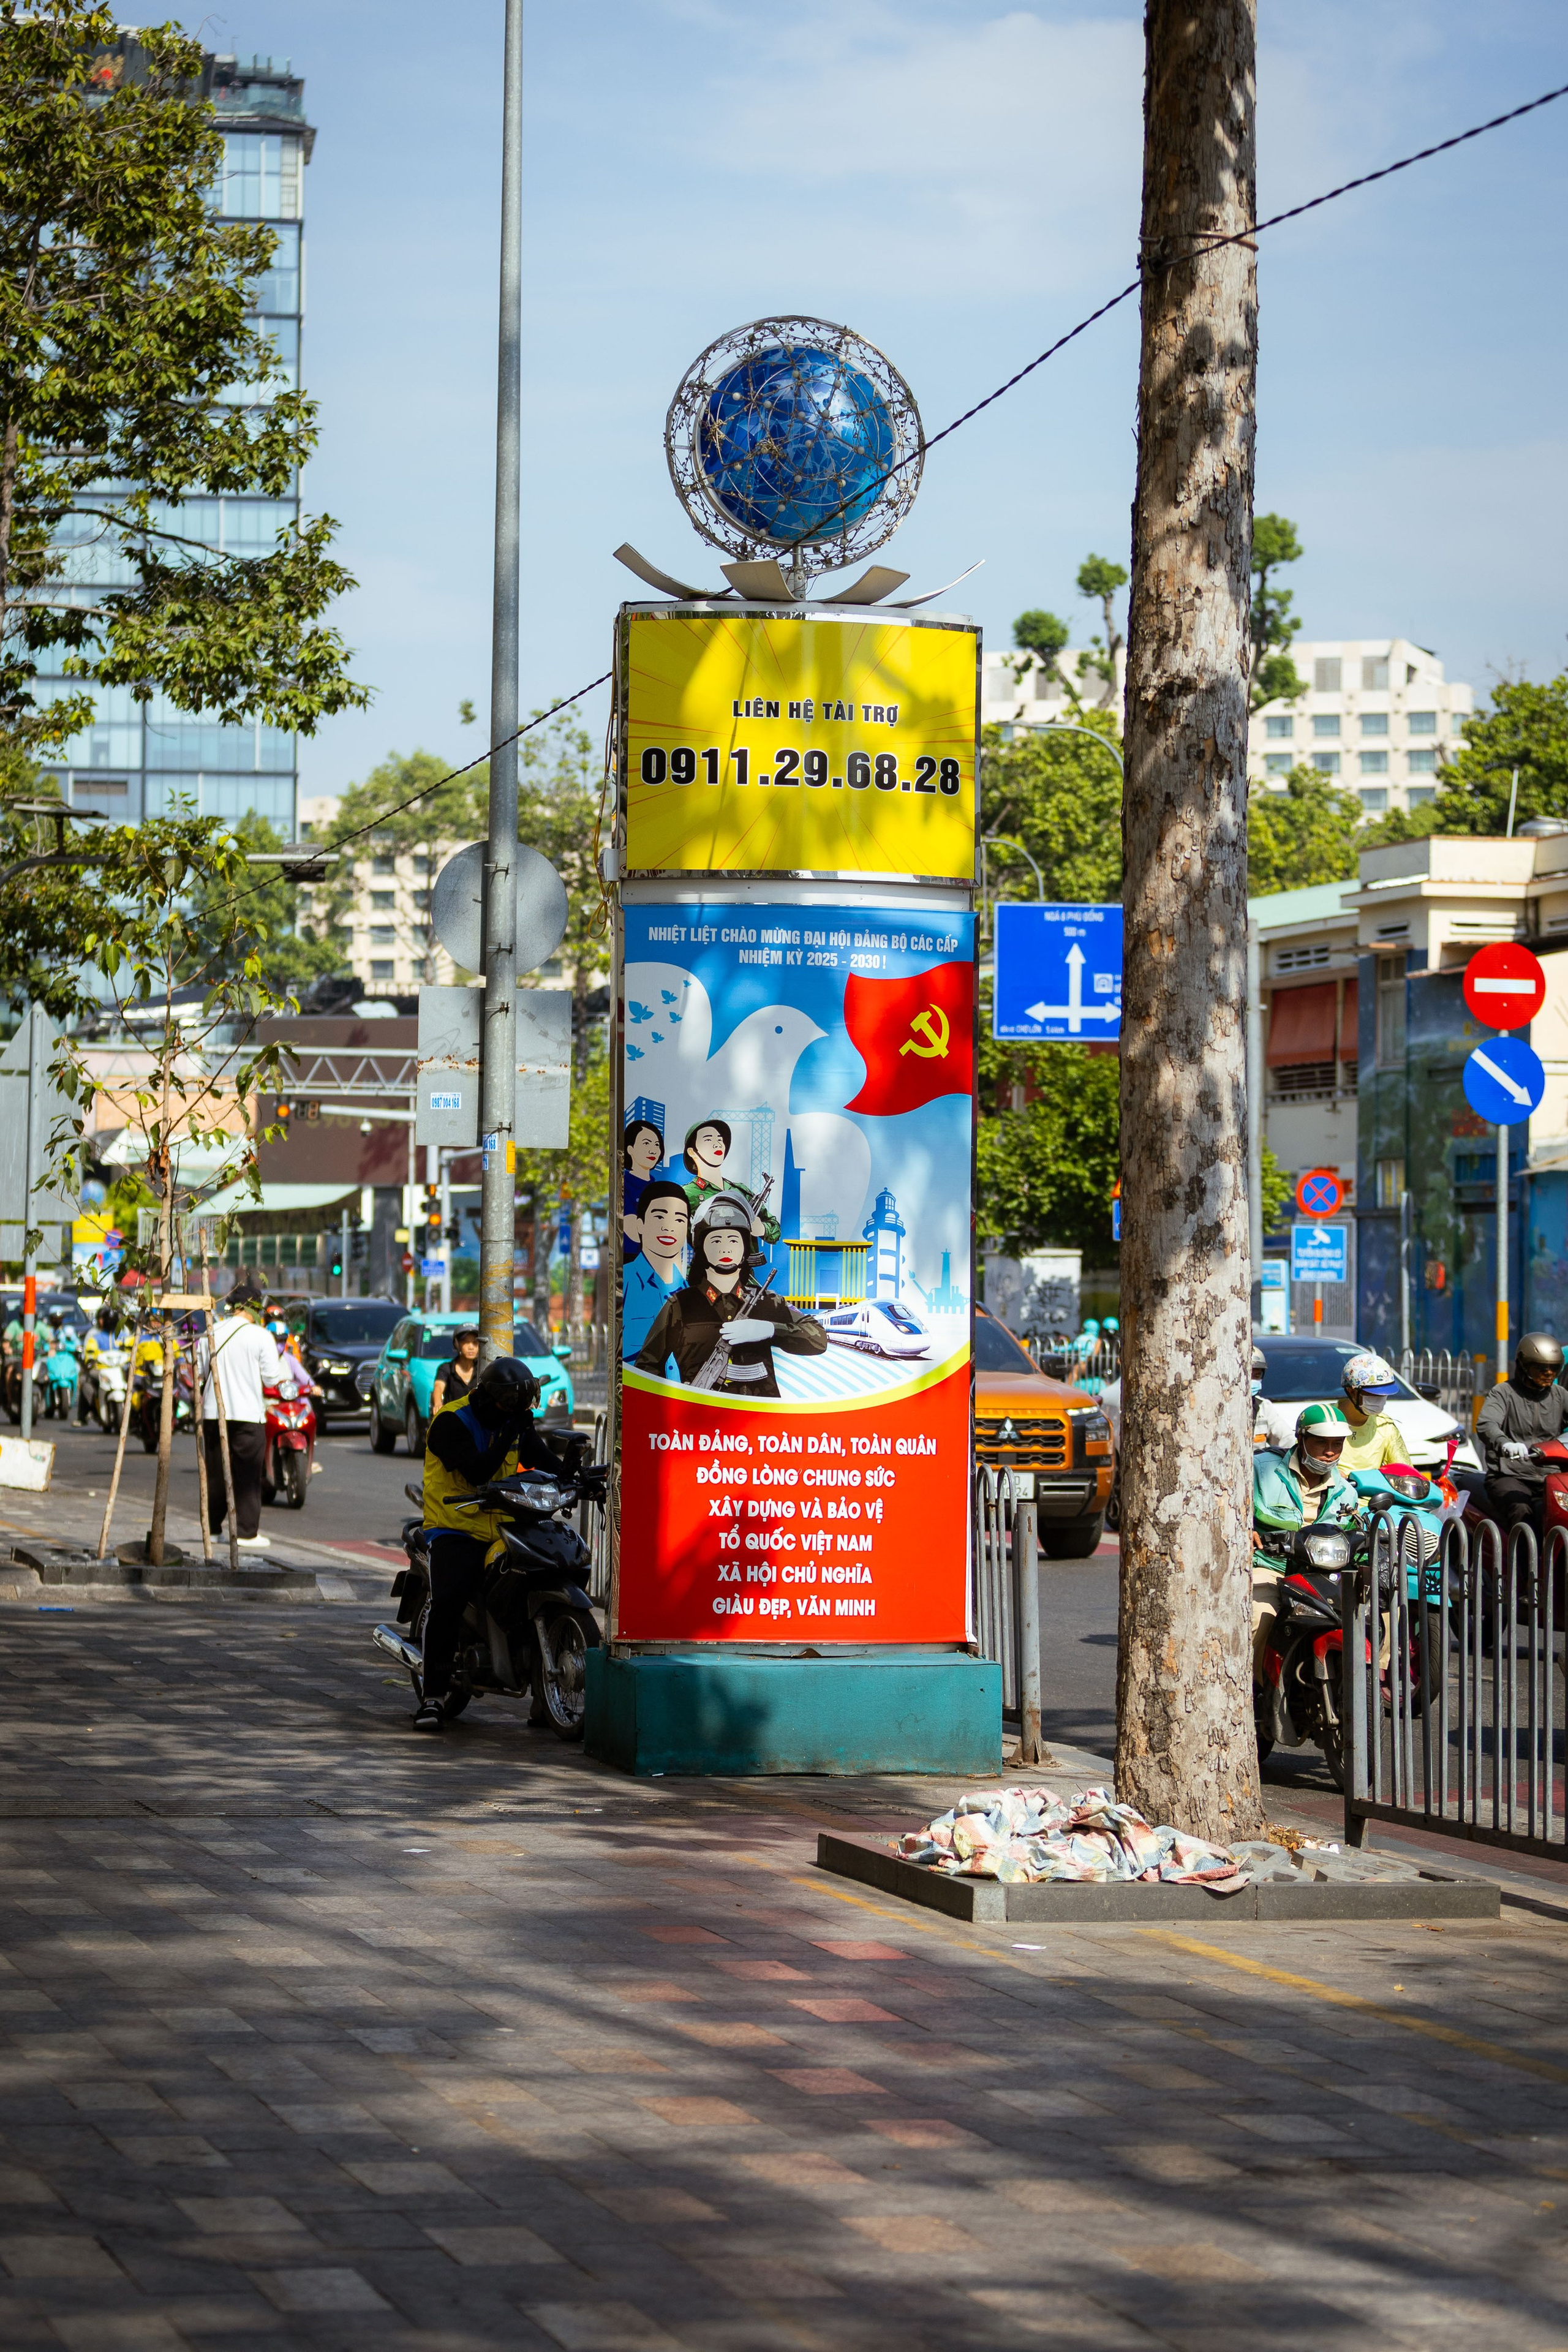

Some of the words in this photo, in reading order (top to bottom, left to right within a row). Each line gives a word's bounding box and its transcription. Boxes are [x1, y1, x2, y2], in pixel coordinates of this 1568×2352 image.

[733, 697, 780, 718] LIÊN
[788, 698, 814, 723] HỆ
[821, 699, 854, 722] TÀI
[861, 704, 899, 728] TRỢ
[641, 747, 960, 796] 0911.29.68.28
[649, 924, 687, 944] NHIỆT
[690, 925, 717, 944] LIỆT
[722, 926, 756, 943] CHÀO
[761, 927, 800, 944] MỪNG
[804, 930, 826, 948] ĐẠI
[829, 930, 851, 949] HỘI
[854, 929, 888, 949] ĐẢNG
[891, 933, 907, 952] BỘ
[911, 934, 933, 952] CÁC
[937, 934, 958, 952] CẤP
[739, 947, 782, 967] NHIỆM
[786, 948, 803, 965] KỲ
[807, 952, 838, 967] 2025
[649, 1429, 693, 1450] TOÀN
[699, 1429, 752, 1455] ĐẢNG,
[758, 1431, 802, 1453] TOÀN
[807, 1433, 846, 1457] DÂN,
[850, 1433, 891, 1454] TOÀN
[895, 1434, 936, 1455] QUÂN
[696, 1459, 747, 1484] ĐỒNG
[753, 1464, 797, 1485] LÒNG
[803, 1469, 861, 1487] CHUNG
[865, 1466, 895, 1487] SỨC
[709, 1496, 743, 1516] XÂY
[748, 1499, 796, 1521] DỰNG
[800, 1497, 823, 1518] VÀ
[827, 1496, 861, 1519] BẢO
[865, 1498, 883, 1523] VỆ
[719, 1524, 740, 1549] TỔ
[745, 1527, 796, 1550] QUỐC
[801, 1530, 833, 1555] VIỆT
[837, 1535, 872, 1551] NAM
[718, 1562, 741, 1581] XÃ
[747, 1561, 777, 1586] HỘI
[782, 1561, 816, 1583] CHỦ
[821, 1563, 872, 1583] NGHĨA
[713, 1593, 753, 1615] GIÀU
[759, 1599, 791, 1619] ĐẸP,
[796, 1595, 831, 1615] VĂN
[835, 1599, 875, 1616] MINH
